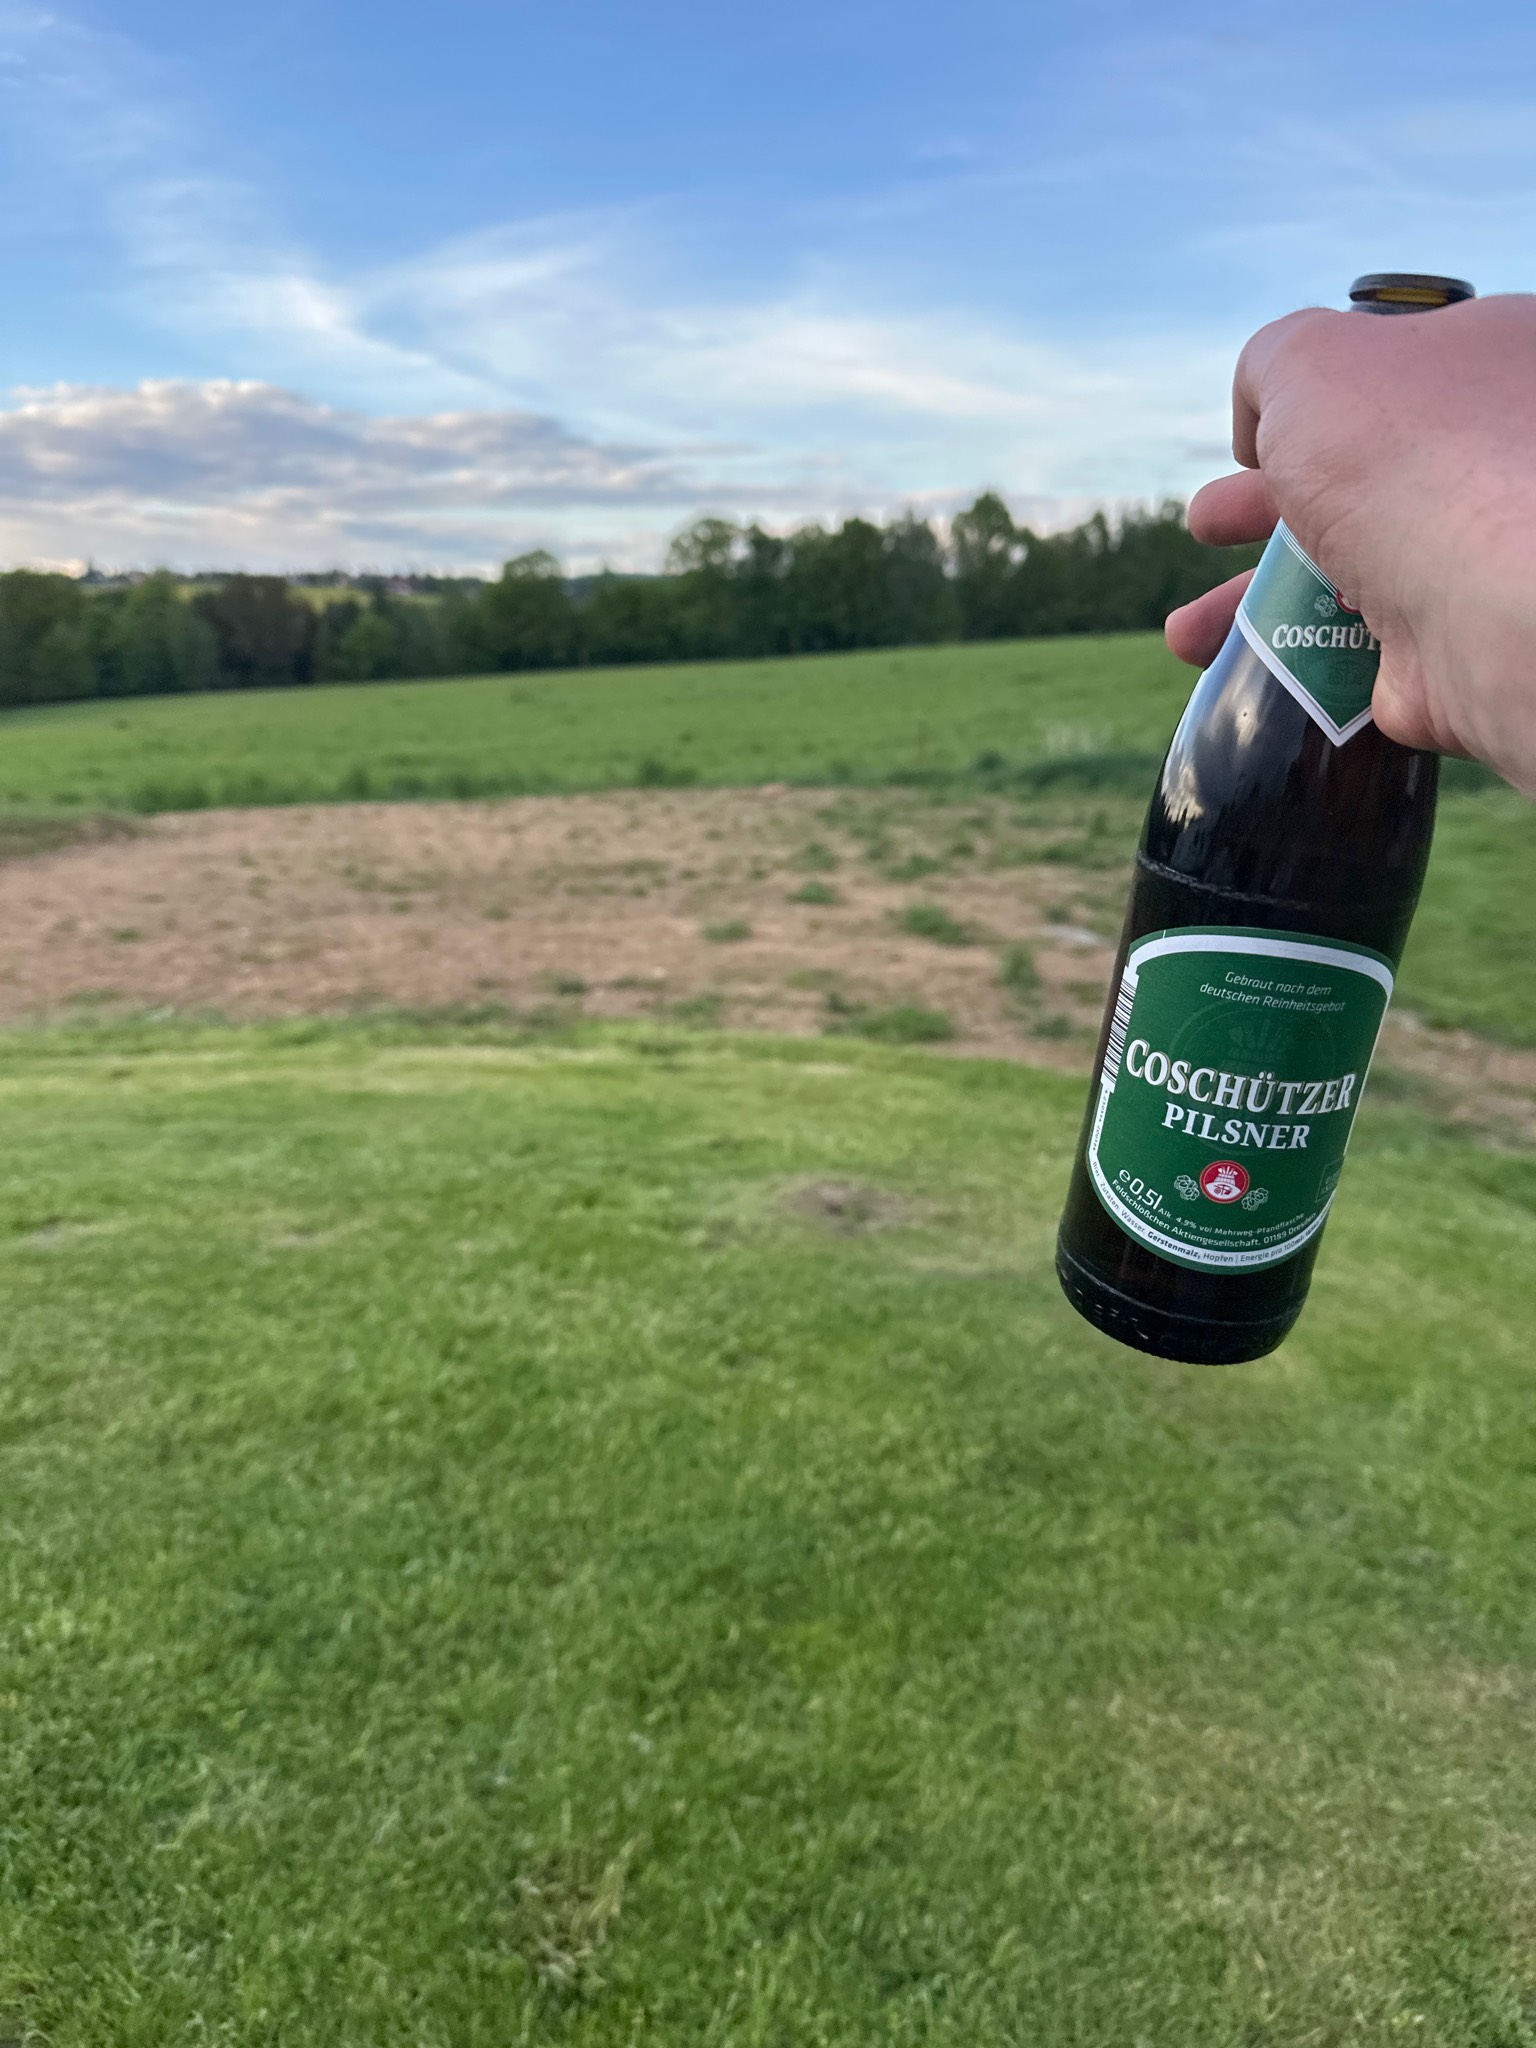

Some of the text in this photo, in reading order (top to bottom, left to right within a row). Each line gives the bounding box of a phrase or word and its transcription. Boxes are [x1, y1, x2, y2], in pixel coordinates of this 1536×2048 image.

[1271, 623, 1381, 650] COSCHÜT
[1200, 982, 1346, 1014] deutschen Reinheitsgebot
[1225, 971, 1332, 996] Gebraut nach dem
[1126, 1038, 1358, 1117] COSCHÜTZER
[1161, 1101, 1310, 1150] PILSNER
[1263, 1230, 1287, 1244] 01189
